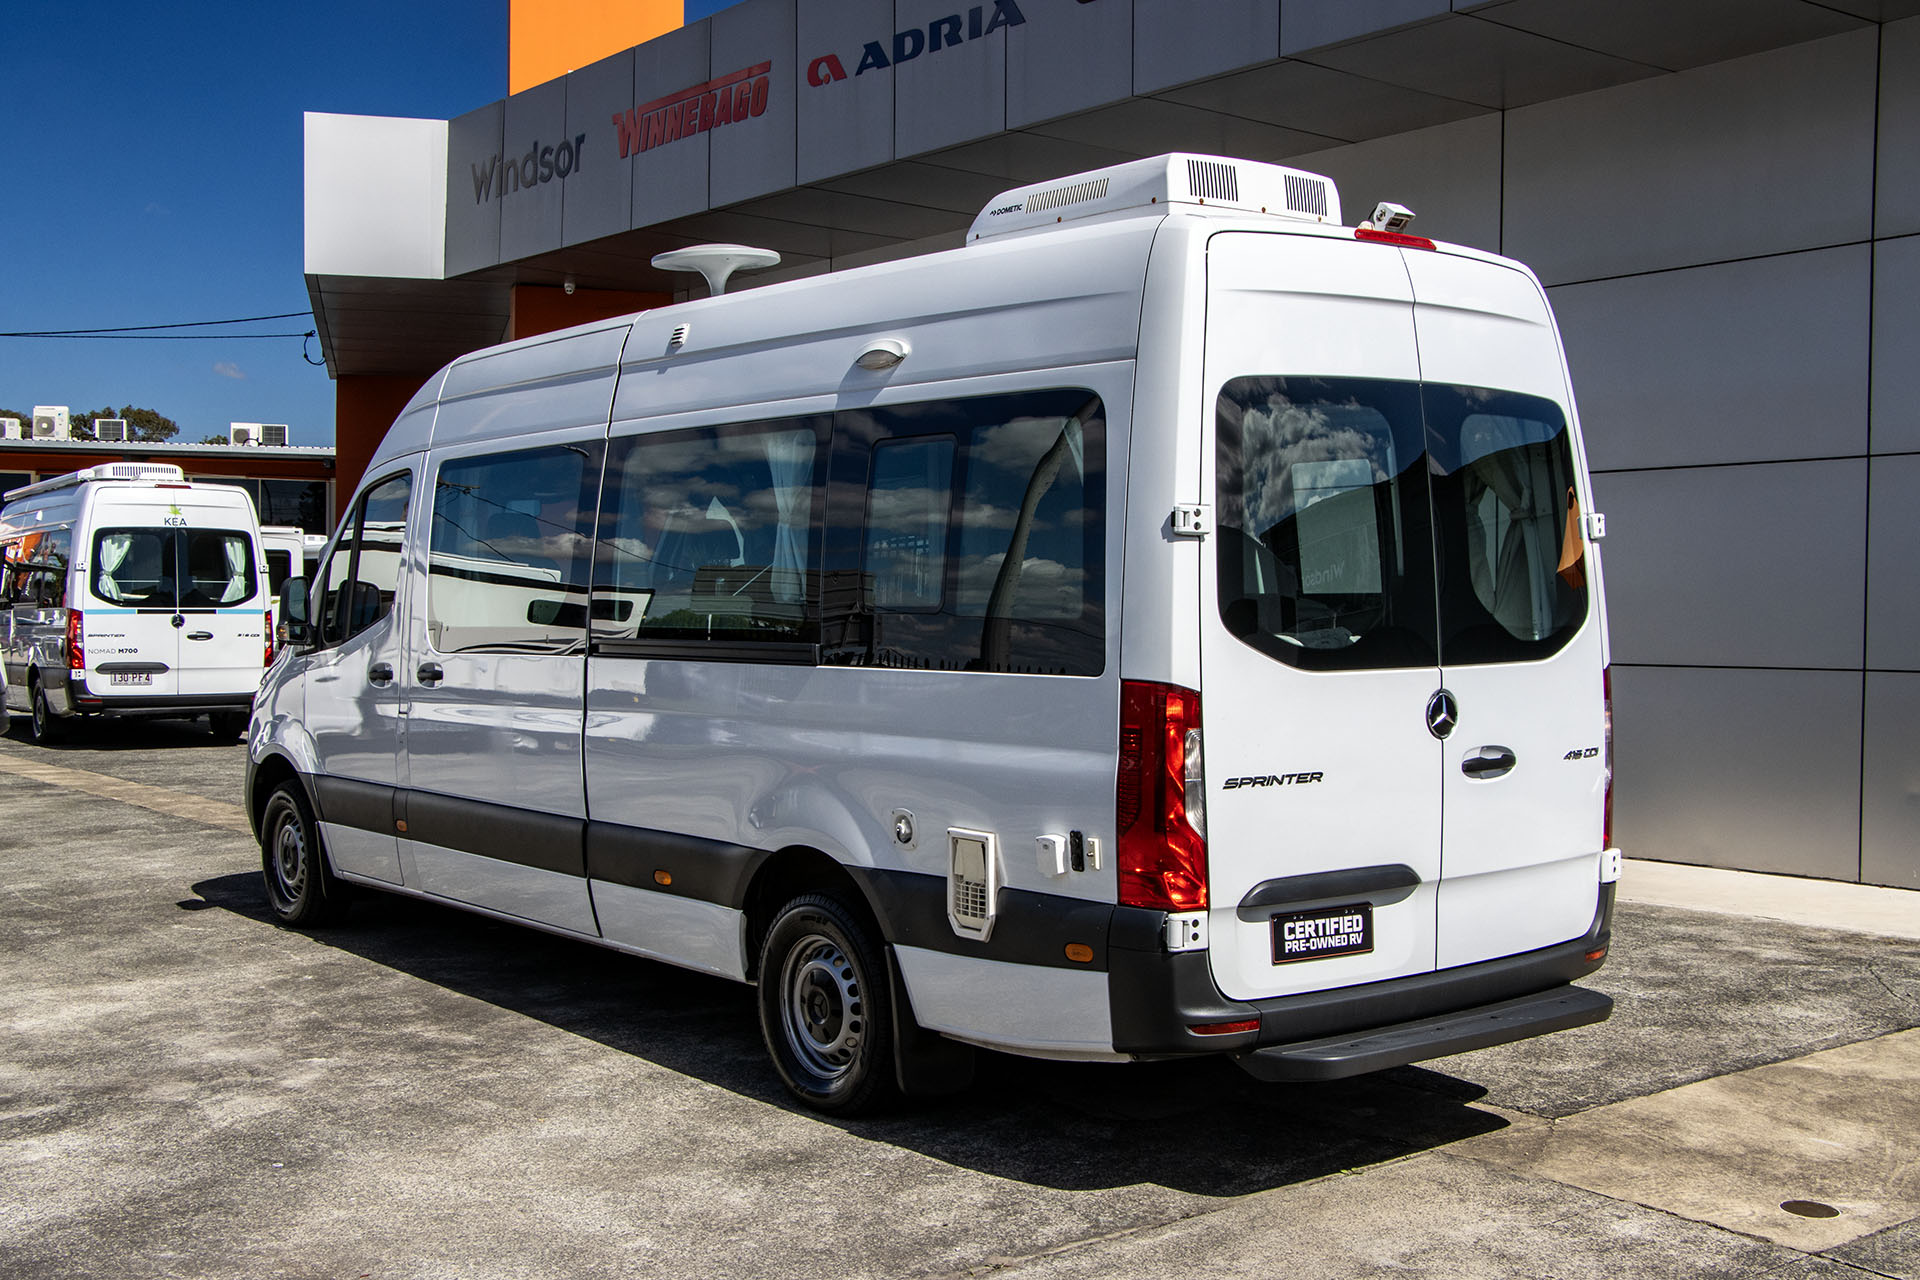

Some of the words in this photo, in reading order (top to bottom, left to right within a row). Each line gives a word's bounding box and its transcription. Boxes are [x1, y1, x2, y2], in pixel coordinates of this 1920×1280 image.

[854, 0, 1027, 77] ADRIA
[612, 60, 772, 160] WINNEBAGO
[471, 133, 587, 206] Windsor
[164, 517, 187, 526] KEA
[1222, 771, 1324, 790] SPRINTER
[1283, 914, 1364, 941] CERTIFIED
[1285, 933, 1349, 953] PRE-OWNED
[1349, 932, 1364, 946] RV
